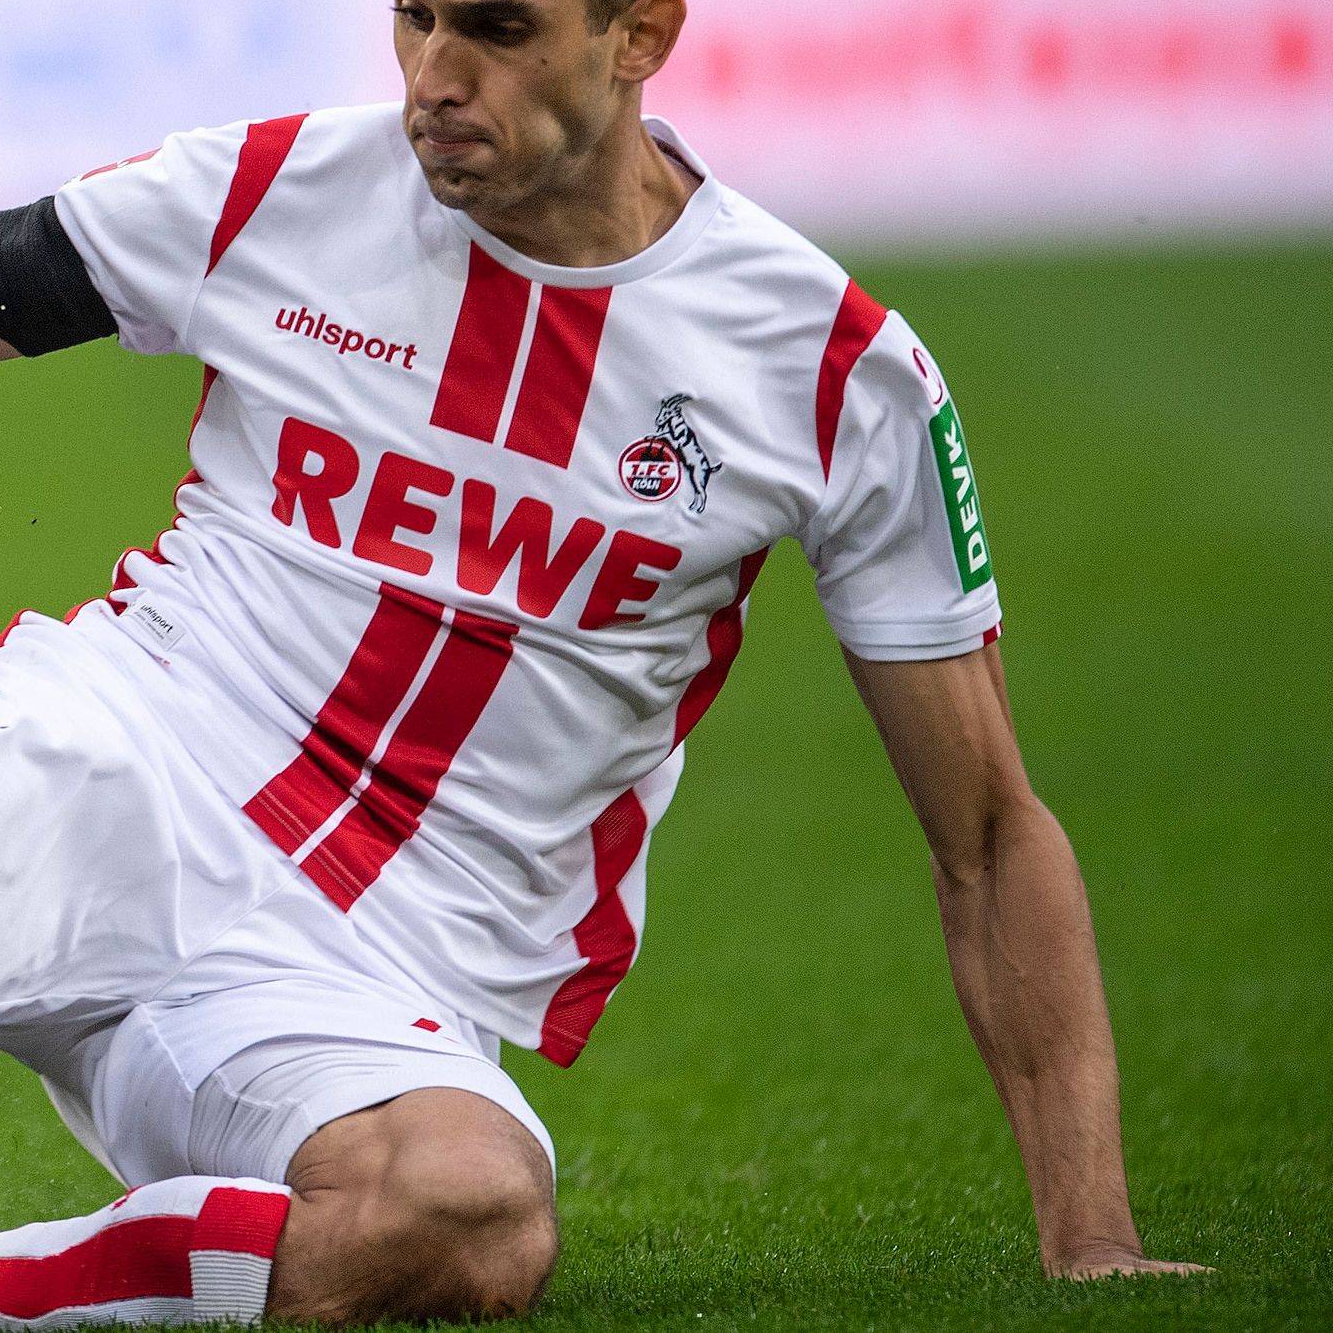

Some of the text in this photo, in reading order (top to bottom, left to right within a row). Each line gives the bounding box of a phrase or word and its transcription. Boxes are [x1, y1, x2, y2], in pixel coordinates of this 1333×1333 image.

[275, 307, 418, 370] uhlsport
[271, 417, 683, 631] REWE
[632, 478, 661, 490] KÖLN
[944, 420, 988, 575] DEVK
